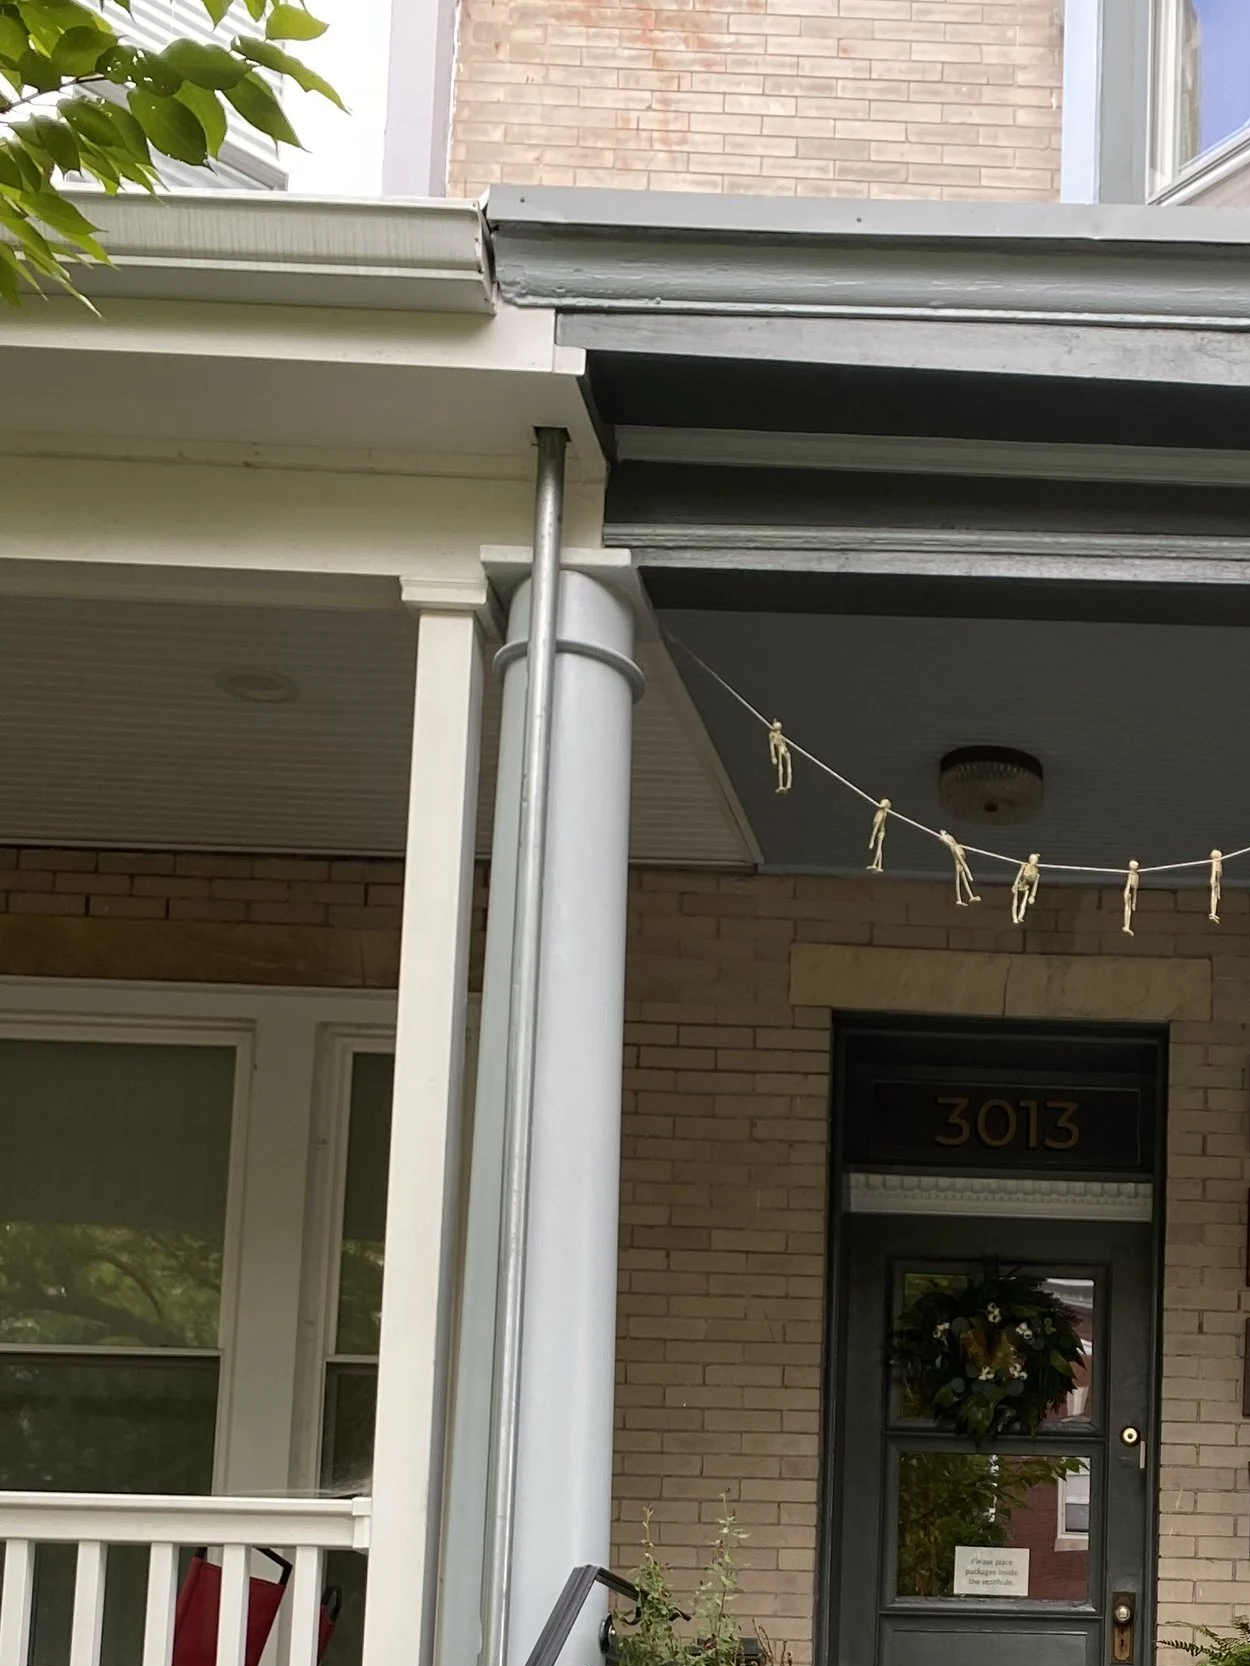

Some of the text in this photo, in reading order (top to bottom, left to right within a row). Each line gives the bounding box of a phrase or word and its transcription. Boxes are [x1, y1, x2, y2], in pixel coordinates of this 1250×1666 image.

[934, 1096, 1080, 1150] 3013
[971, 1558, 1013, 1567] Please place
[965, 1568, 996, 1576] packages
